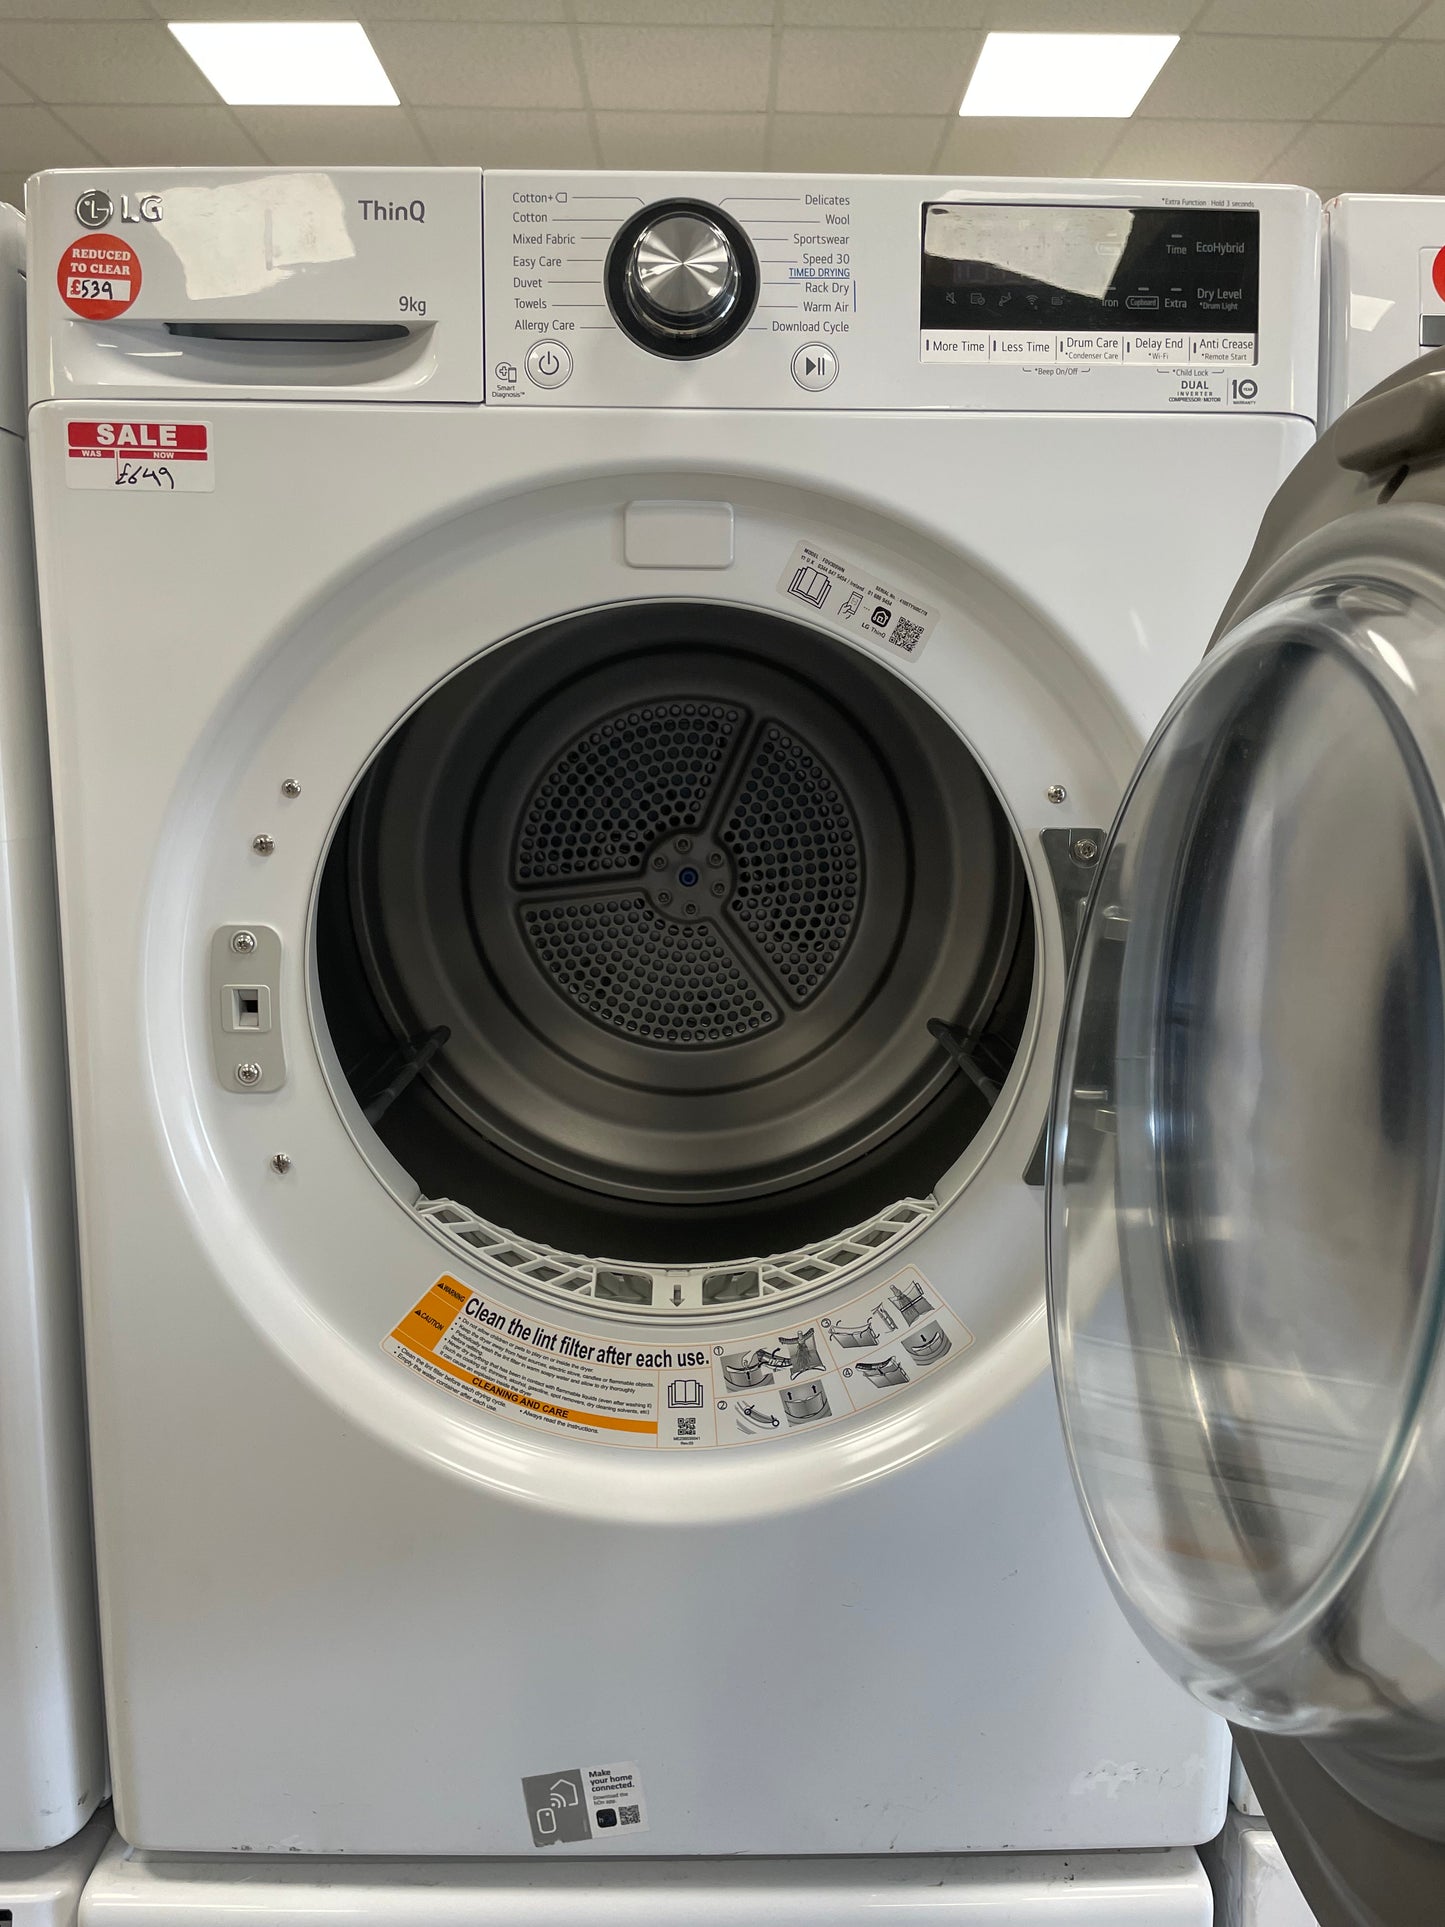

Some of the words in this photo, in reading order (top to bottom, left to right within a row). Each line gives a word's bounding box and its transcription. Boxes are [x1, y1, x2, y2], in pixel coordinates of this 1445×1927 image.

[512, 192, 553, 203] Cotton+
[805, 194, 850, 205] Delicates
[121, 195, 163, 223] LG
[358, 200, 425, 223] ThinQ
[512, 211, 548, 223] Cotton
[825, 213, 850, 225] Wool
[512, 233, 543, 245] Mixed
[546, 233, 576, 245] Fabric
[793, 233, 850, 247] Sportswear
[72, 248, 131, 261] REDUCED
[1166, 244, 1187, 255] Time
[1196, 242, 1245, 256] EcoHybrid
[513, 256, 536, 270] Easy
[539, 256, 562, 267] Care
[803, 253, 833, 266] Speed
[836, 253, 850, 265] 30
[70, 262, 87, 273] TO
[90, 263, 131, 275] CLEAR
[789, 267, 816, 277] TIMED
[818, 267, 850, 277] DRYING
[513, 277, 543, 288] Duvet
[805, 281, 829, 293] Rack
[832, 282, 850, 296] Dry
[70, 279, 113, 300] £539
[1197, 288, 1214, 301] Dry
[1217, 288, 1242, 299] Level
[399, 296, 426, 316] 9kg
[514, 298, 547, 309] Towels
[803, 301, 831, 313] Warm
[834, 301, 850, 312] Air
[1102, 298, 1119, 307] Iron
[1164, 298, 1188, 308] Extra
[1222, 302, 1238, 311] Light
[514, 319, 549, 333] Allergy
[552, 319, 575, 331] Care
[772, 320, 820, 332] Download
[823, 321, 850, 335] Cycle
[933, 340, 958, 352] More
[962, 340, 985, 352] Time
[1001, 341, 1024, 352] Less
[1026, 341, 1050, 352] Time
[1066, 337, 1093, 348] Drum
[1096, 337, 1119, 348] Care
[1135, 337, 1162, 351] Delay
[1165, 338, 1183, 349] End
[1199, 338, 1219, 349] Anti
[1221, 338, 1254, 349] Crease
[1104, 352, 1119, 360] Care
[1231, 353, 1247, 361] Start
[1056, 367, 1079, 376] On/Off
[1194, 369, 1209, 377] Lock
[1181, 380, 1209, 390] DUAL
[1232, 379, 1258, 400] 10
[96, 423, 178, 447] SALE
[81, 449, 102, 457] WAS
[153, 451, 175, 459] NOW
[115, 463, 175, 490] £649
[861, 622, 870, 630] LG
[870, 627, 887, 639] ThinQ
[442, 1285, 465, 1302] WARNING
[420, 1312, 444, 1331] CAUTION
[465, 1298, 506, 1330] Clean
[507, 1318, 531, 1340] the
[531, 1327, 557, 1351] lint
[559, 1335, 595, 1360] filter
[596, 1345, 632, 1366] after
[636, 1349, 672, 1368] each
[677, 1351, 709, 1367] use.
[397, 1352, 413, 1367] Empty
[413, 1364, 422, 1372] the
[421, 1370, 436, 1381] water
[435, 1379, 460, 1394] container
[459, 1392, 472, 1400] after
[472, 1398, 485, 1406] each
[401, 1347, 416, 1360] Clean
[415, 1357, 424, 1365] the
[424, 1362, 433, 1371] lint
[432, 1367, 444, 1377] filter
[444, 1374, 461, 1386] before
[461, 1384, 474, 1393] each
[474, 1391, 491, 1402] drying
[491, 1398, 506, 1407] cycle.
[472, 1377, 518, 1402] CLEANING
[519, 1397, 540, 1409] AND
[542, 1404, 569, 1418] CARE
[522, 1409, 542, 1420] Always
[566, 1422, 598, 1433] instructions.
[589, 1770, 611, 1778] Make
[590, 1777, 608, 1786] your
[610, 1774, 633, 1783] home
[591, 1781, 635, 1792] connected.
